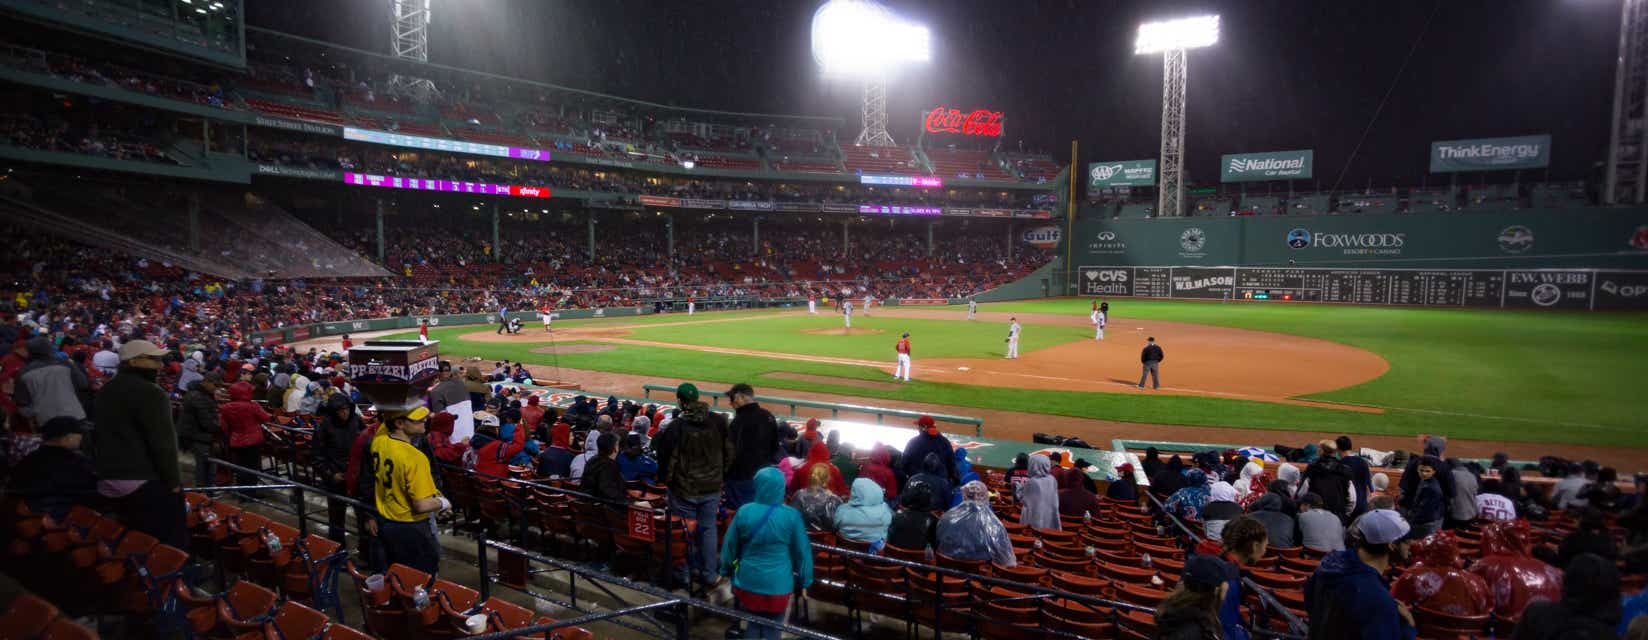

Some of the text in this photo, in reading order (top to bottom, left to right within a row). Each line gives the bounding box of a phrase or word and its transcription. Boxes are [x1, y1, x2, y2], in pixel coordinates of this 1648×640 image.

[1246, 157, 1304, 171] National
[519, 187, 540, 197] xfinity
[1024, 230, 1060, 242] Gulf
[1314, 232, 1404, 247] FOXWOODS
[1100, 270, 1128, 281] CVS
[1541, 272, 1588, 284] WEBB
[1087, 282, 1127, 294] Health
[350, 364, 409, 381] PRETZEL
[408, 356, 439, 381] PRETZEL
[634, 523, 650, 535] 22
